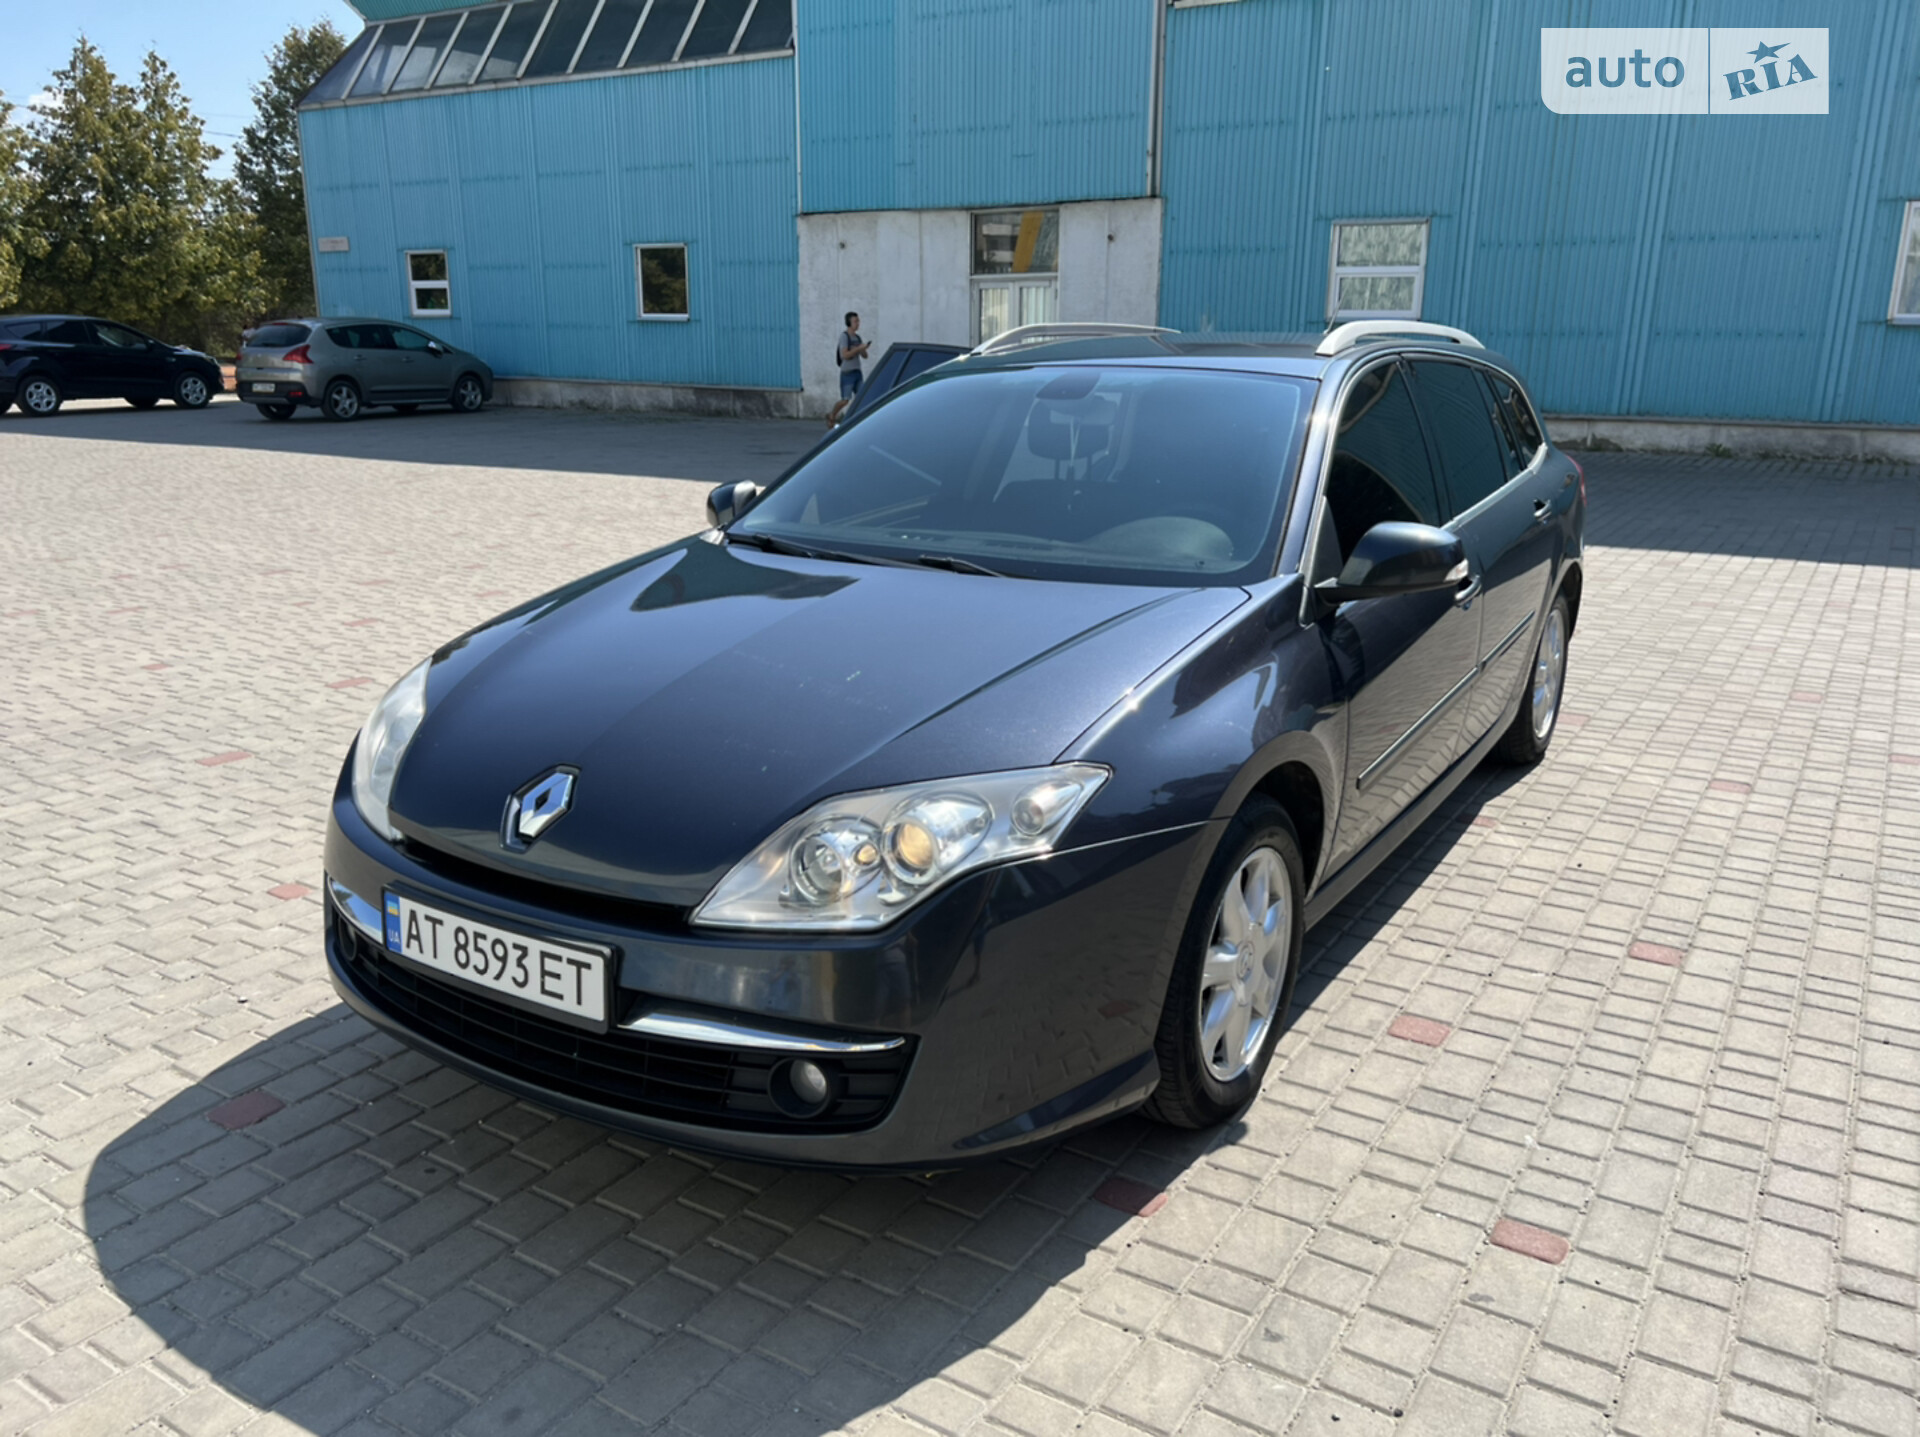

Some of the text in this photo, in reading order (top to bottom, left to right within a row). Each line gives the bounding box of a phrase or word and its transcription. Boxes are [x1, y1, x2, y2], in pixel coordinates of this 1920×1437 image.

[388, 928, 401, 944] UA
[406, 909, 592, 1006] AT 8593 ET
